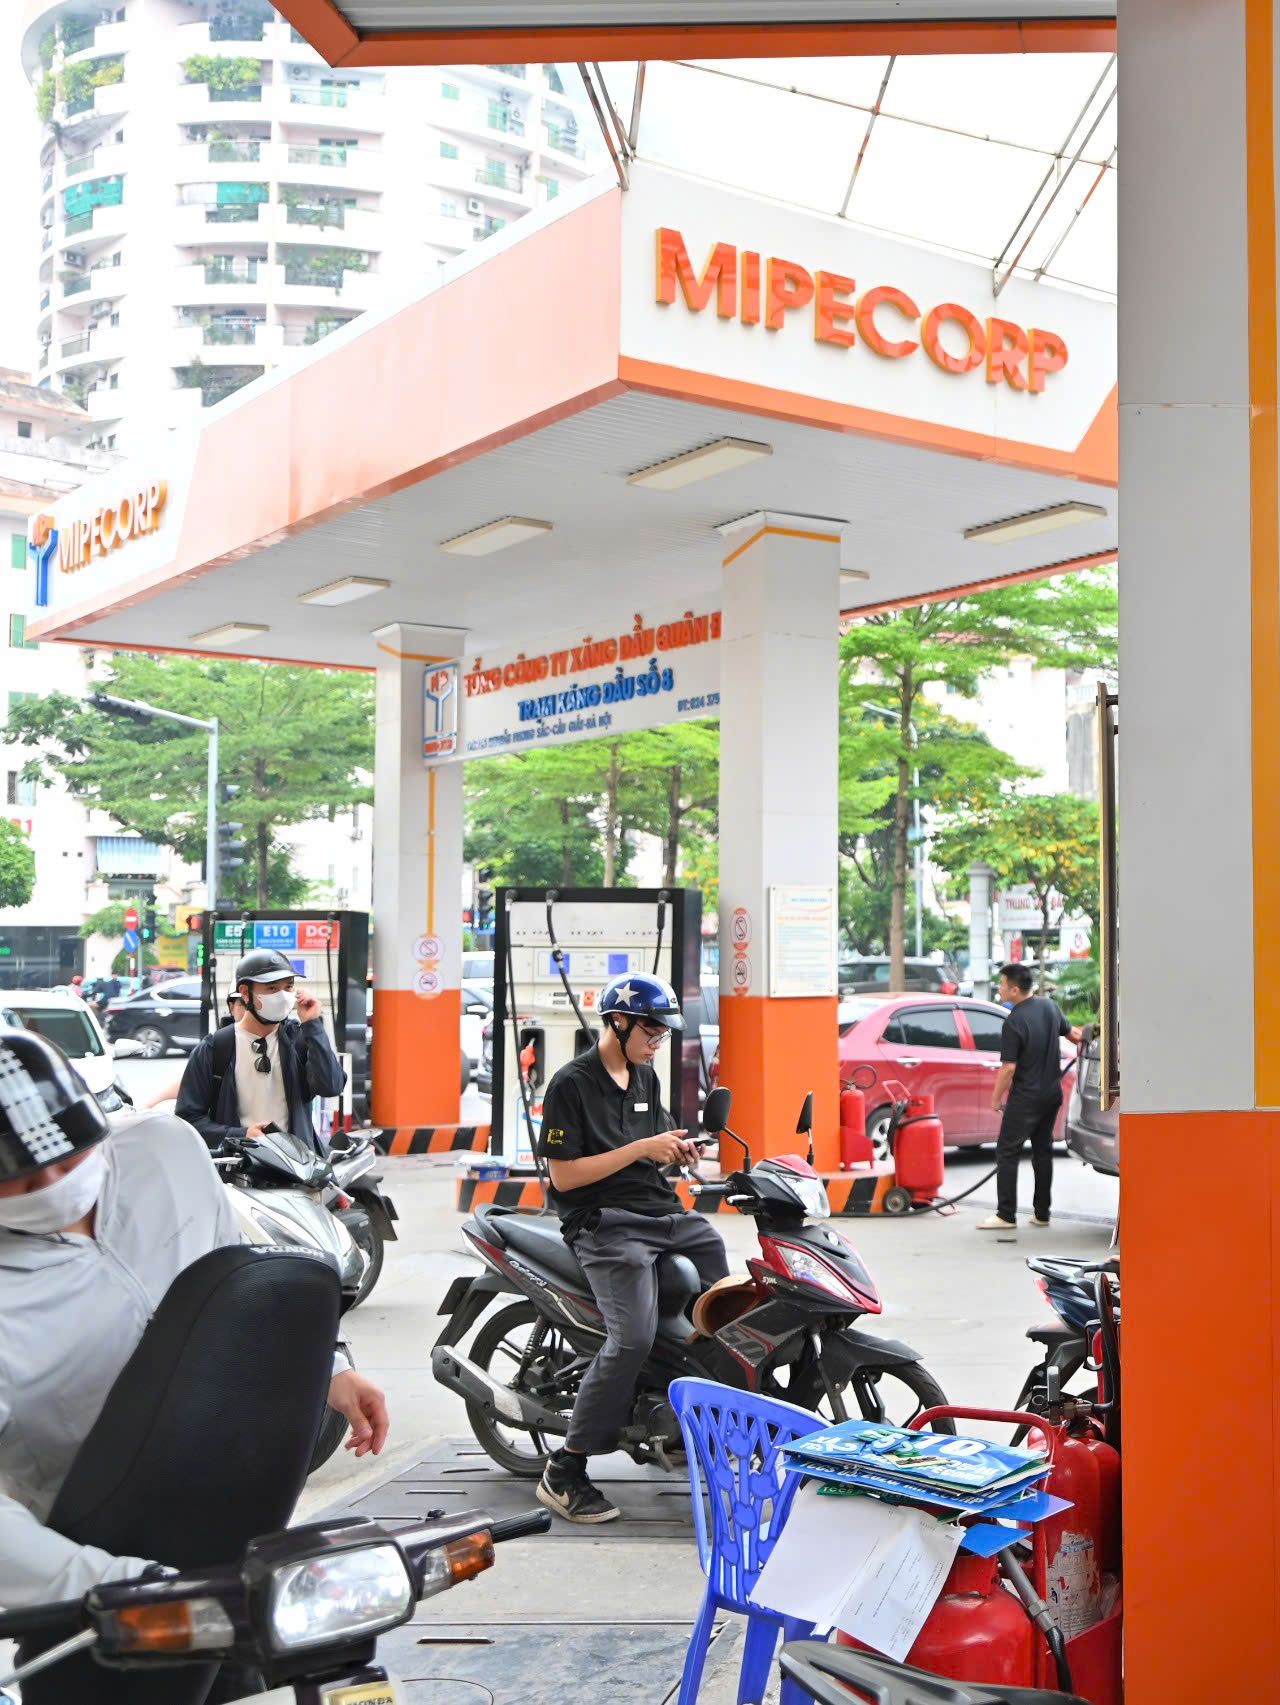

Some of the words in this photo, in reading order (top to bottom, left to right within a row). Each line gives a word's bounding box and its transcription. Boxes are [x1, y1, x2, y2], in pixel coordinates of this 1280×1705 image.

[655, 226, 1070, 394] MIPECORP
[59, 480, 168, 574] MIPECORP
[464, 657, 502, 697] TỔNG
[503, 653, 548, 687] CÔNG
[549, 650, 569, 677] TY
[569, 636, 617, 673] XĂNG
[619, 613, 655, 661] DẦU
[656, 611, 708, 651] QUÂN
[517, 694, 556, 724] TRẠM
[602, 666, 635, 704] DẦU
[636, 657, 661, 696] SỐ
[662, 668, 674, 691] 8
[224, 925, 242, 937] E5
[263, 925, 290, 937] E10
[249, 1245, 325, 1258] HONDA
[762, 1276, 778, 1284] SYM
